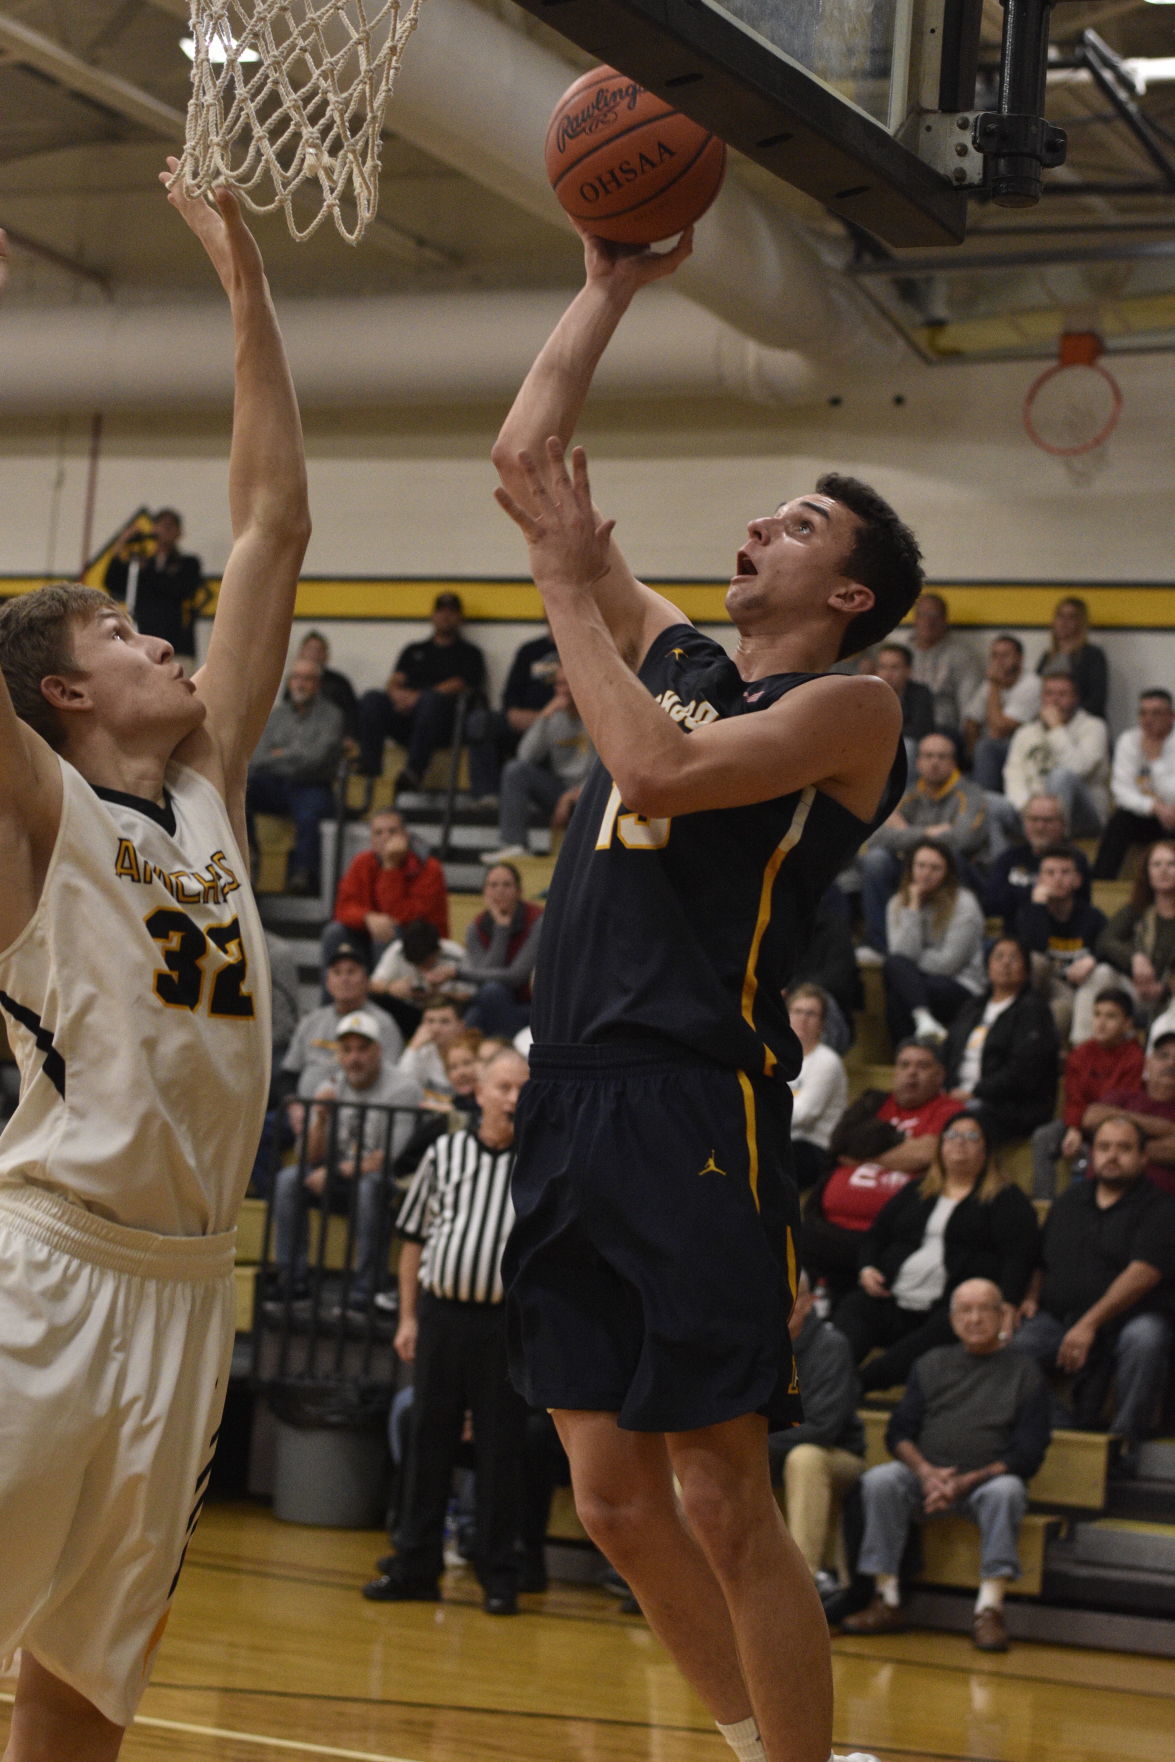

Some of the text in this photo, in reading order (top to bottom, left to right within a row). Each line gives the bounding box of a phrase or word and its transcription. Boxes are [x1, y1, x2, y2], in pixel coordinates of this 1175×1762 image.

[556, 82, 650, 154] Rawling
[578, 140, 677, 203] OHSAA
[143, 913, 256, 1021] 32
